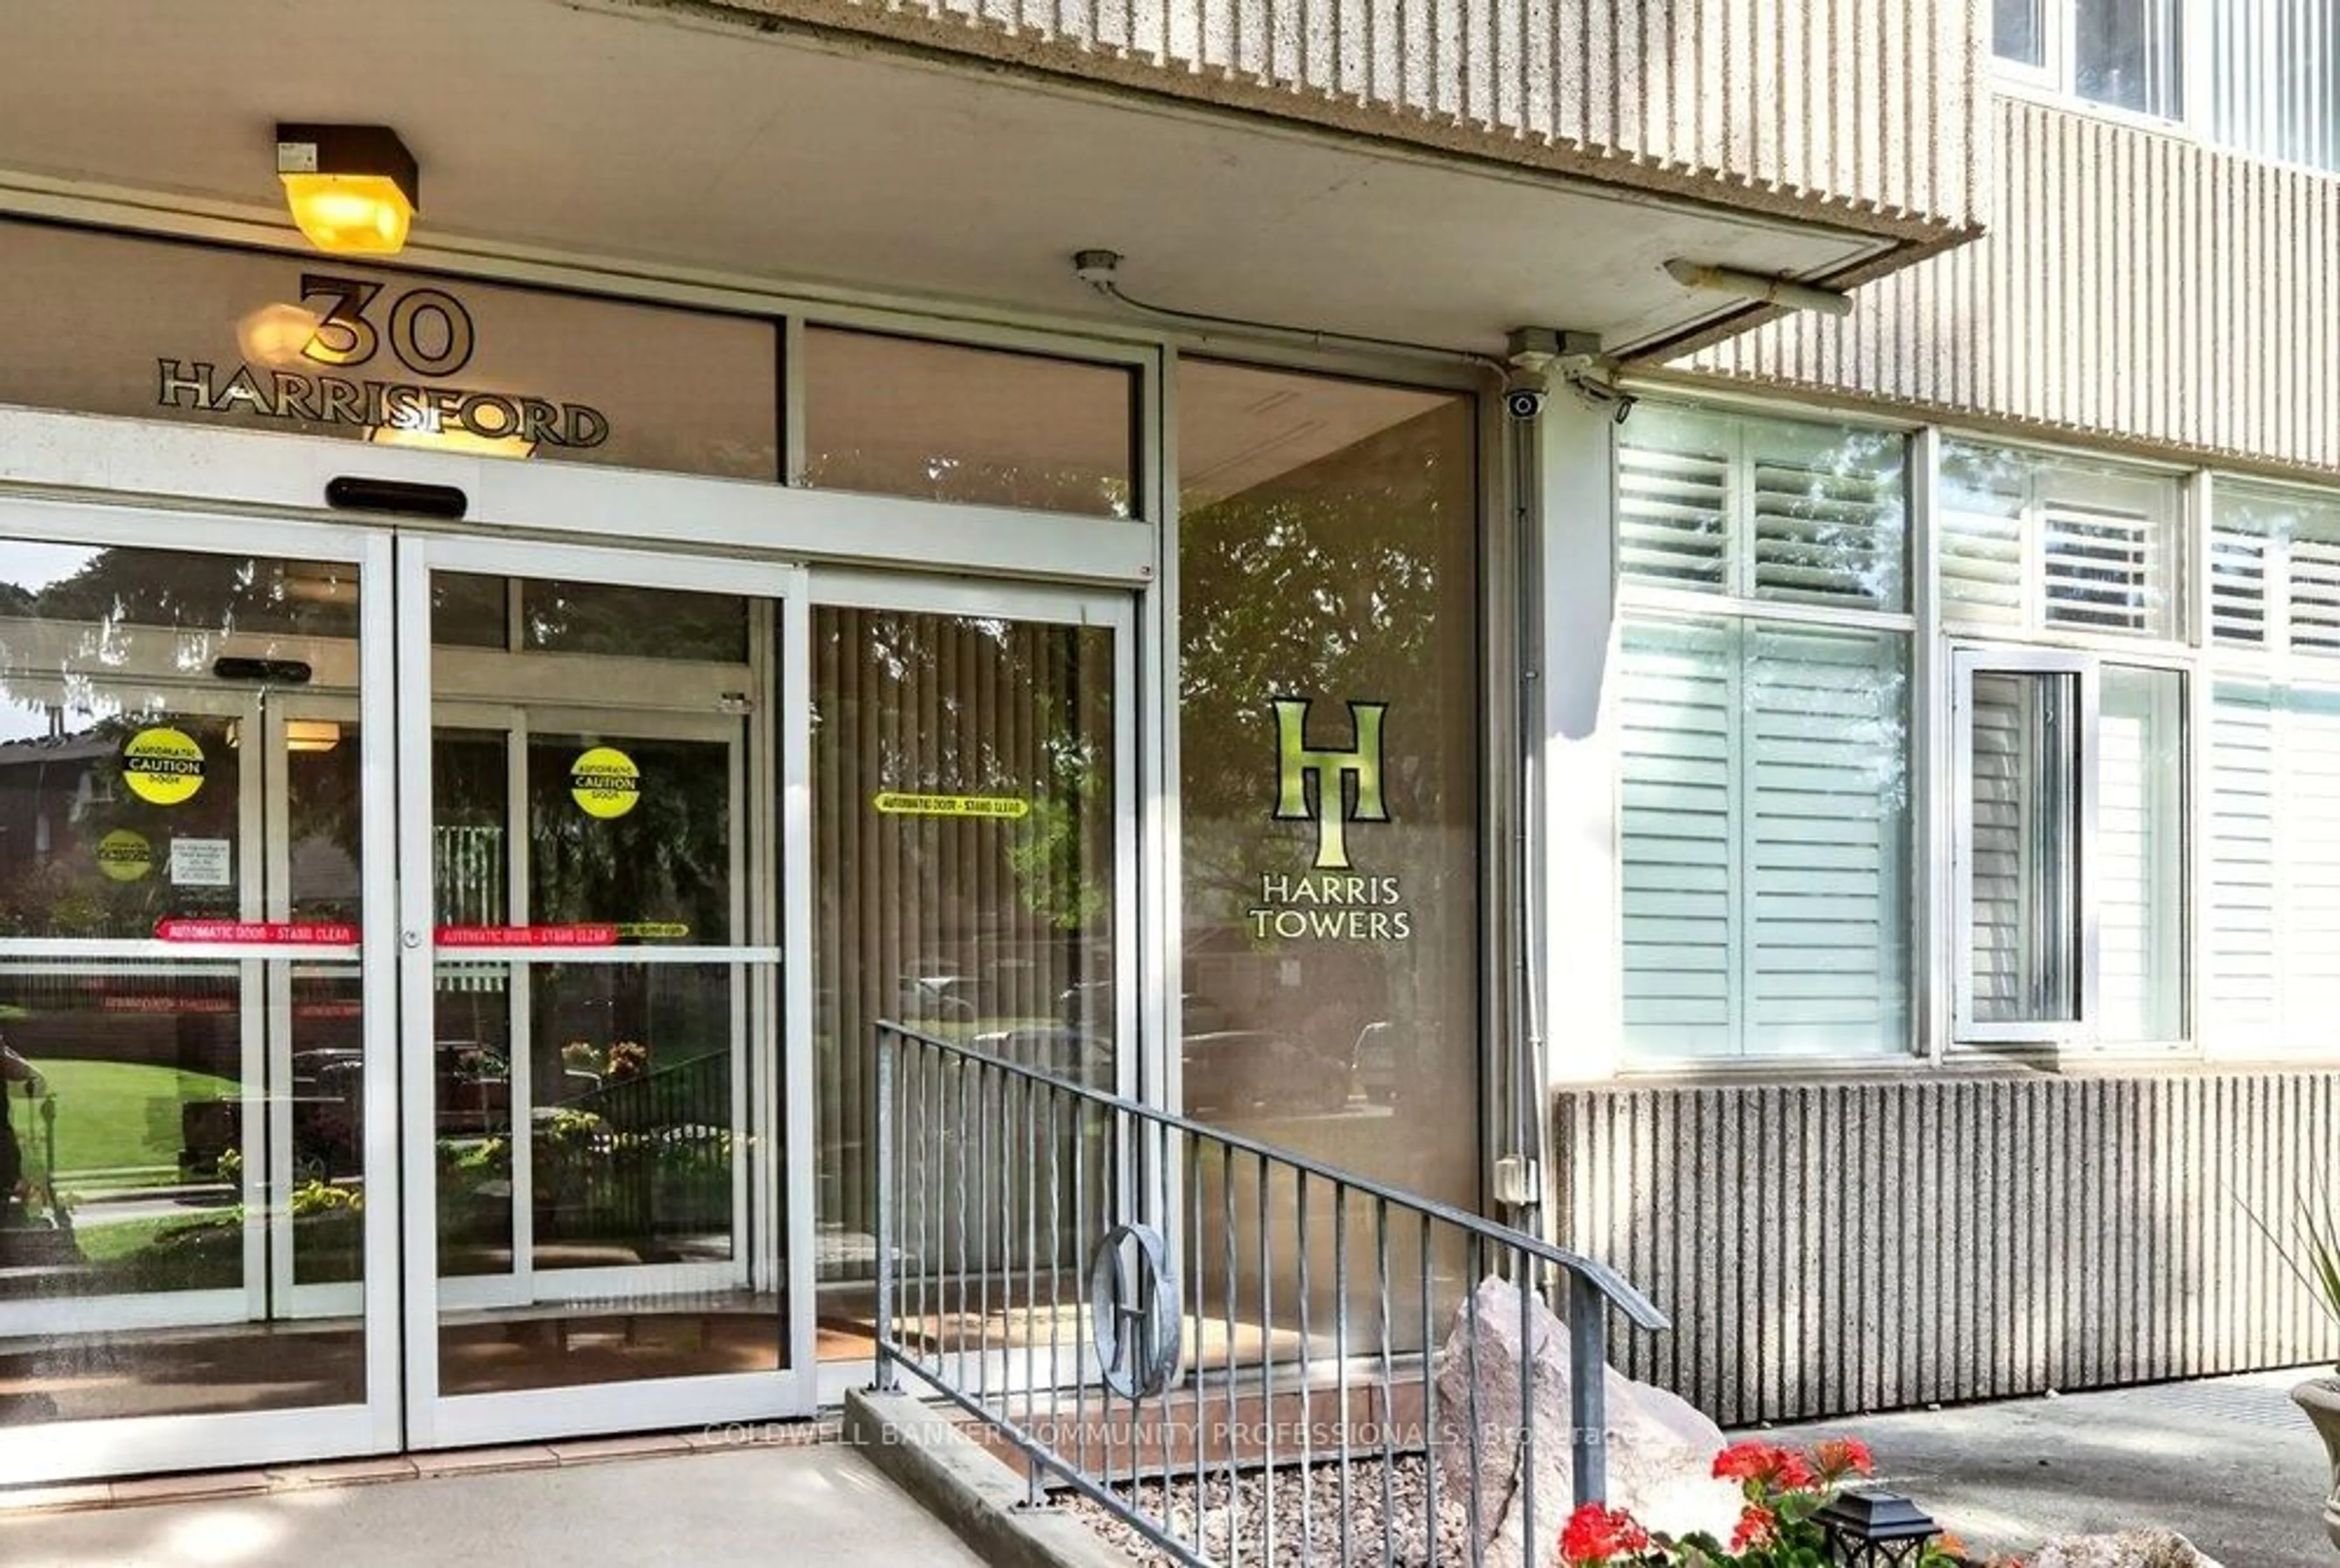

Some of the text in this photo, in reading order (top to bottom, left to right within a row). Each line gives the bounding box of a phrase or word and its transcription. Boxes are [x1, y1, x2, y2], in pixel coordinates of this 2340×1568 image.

[301, 274, 473, 377] 30
[158, 358, 609, 447] HARRISFORD
[129, 758, 200, 773] CAUTION
[575, 777, 635, 789] CAUTION
[1262, 874, 1400, 904] HARRIS
[168, 926, 233, 939] AUTOMATIC
[1248, 909, 1411, 939] TOWERS
